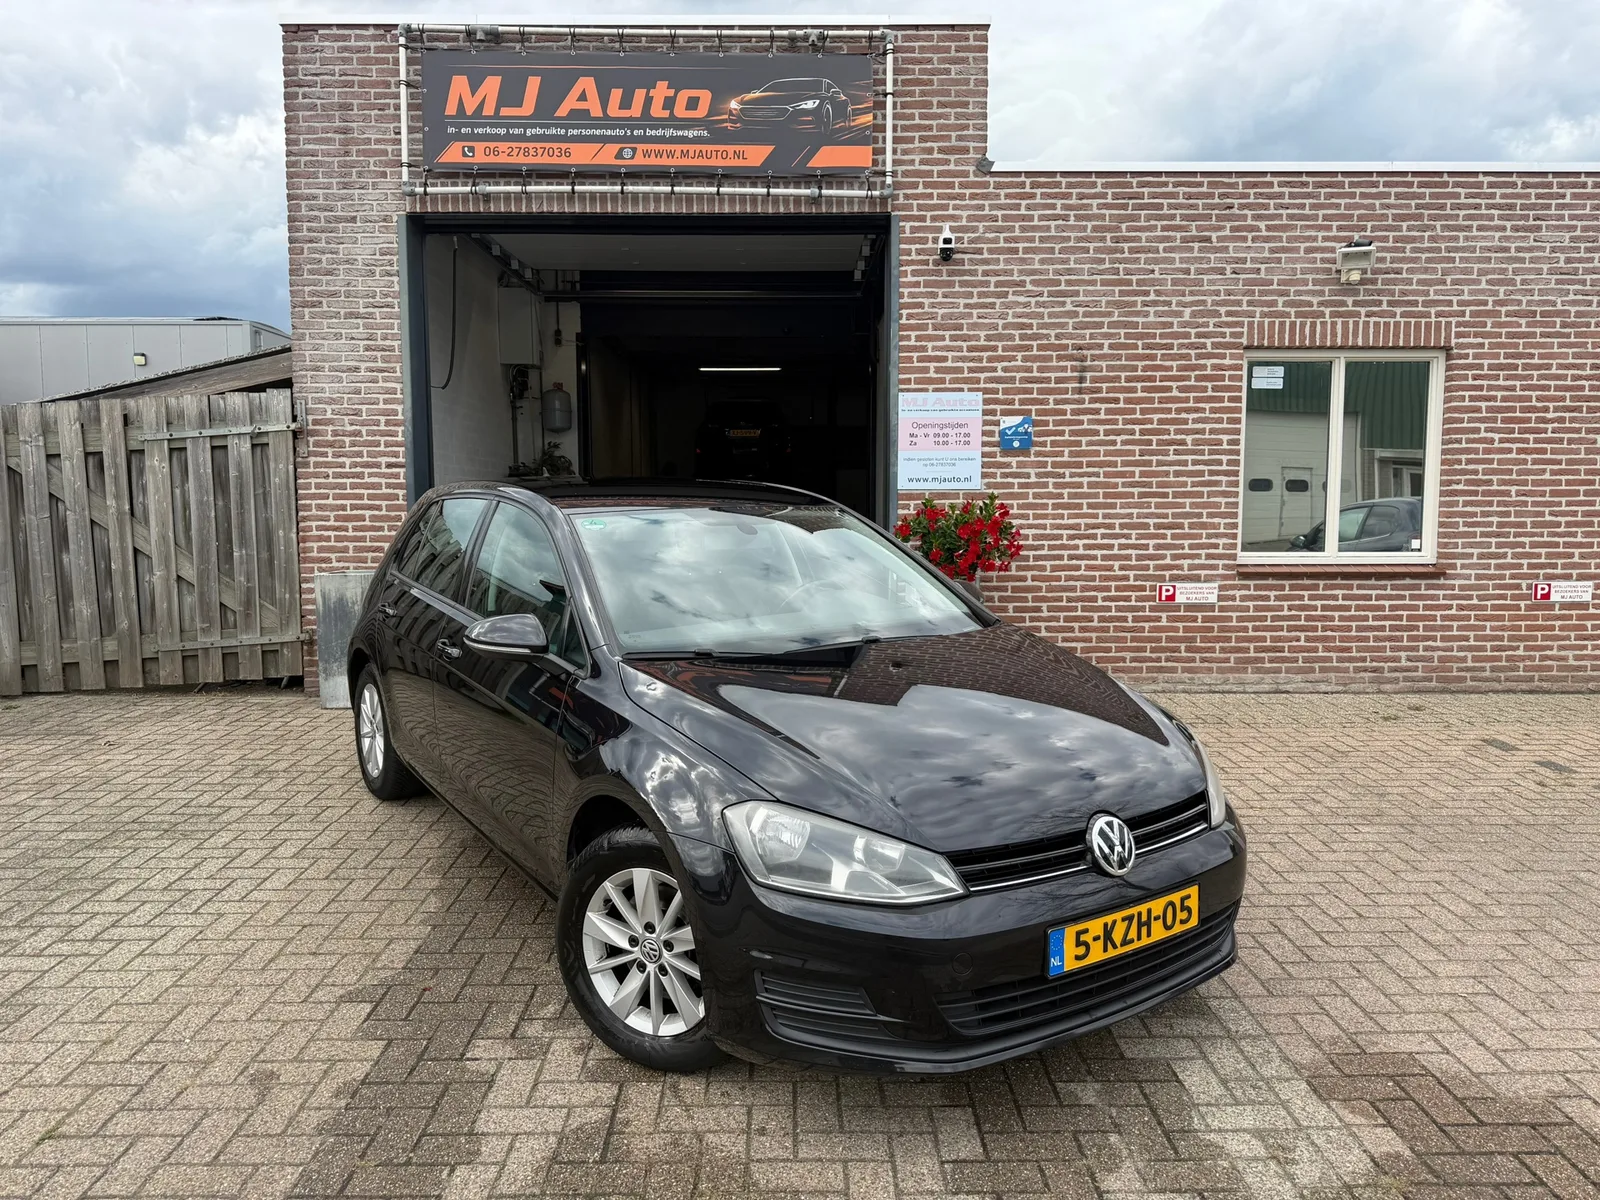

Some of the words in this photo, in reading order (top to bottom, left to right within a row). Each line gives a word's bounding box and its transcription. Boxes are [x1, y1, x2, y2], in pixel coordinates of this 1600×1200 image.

[444, 75, 542, 116] MJ
[553, 76, 713, 119] Auto
[447, 126, 458, 134] in-
[473, 126, 507, 136] verkoop
[509, 127, 524, 135] van
[526, 127, 566, 137] gebruikte
[567, 127, 631, 137] personenauto's
[646, 128, 710, 138] bedrijfswagens.
[483, 146, 572, 158] 06-27837036
[641, 148, 748, 160] WWW.MJAUTO.NL
[902, 398, 928, 407] MJ
[931, 398, 980, 407] Auto
[911, 421, 969, 431] Openingstijden
[907, 475, 972, 484] www.mjauto.nl
[1074, 893, 1193, 961] 5-KZH-05
[1050, 956, 1063, 968] NL
